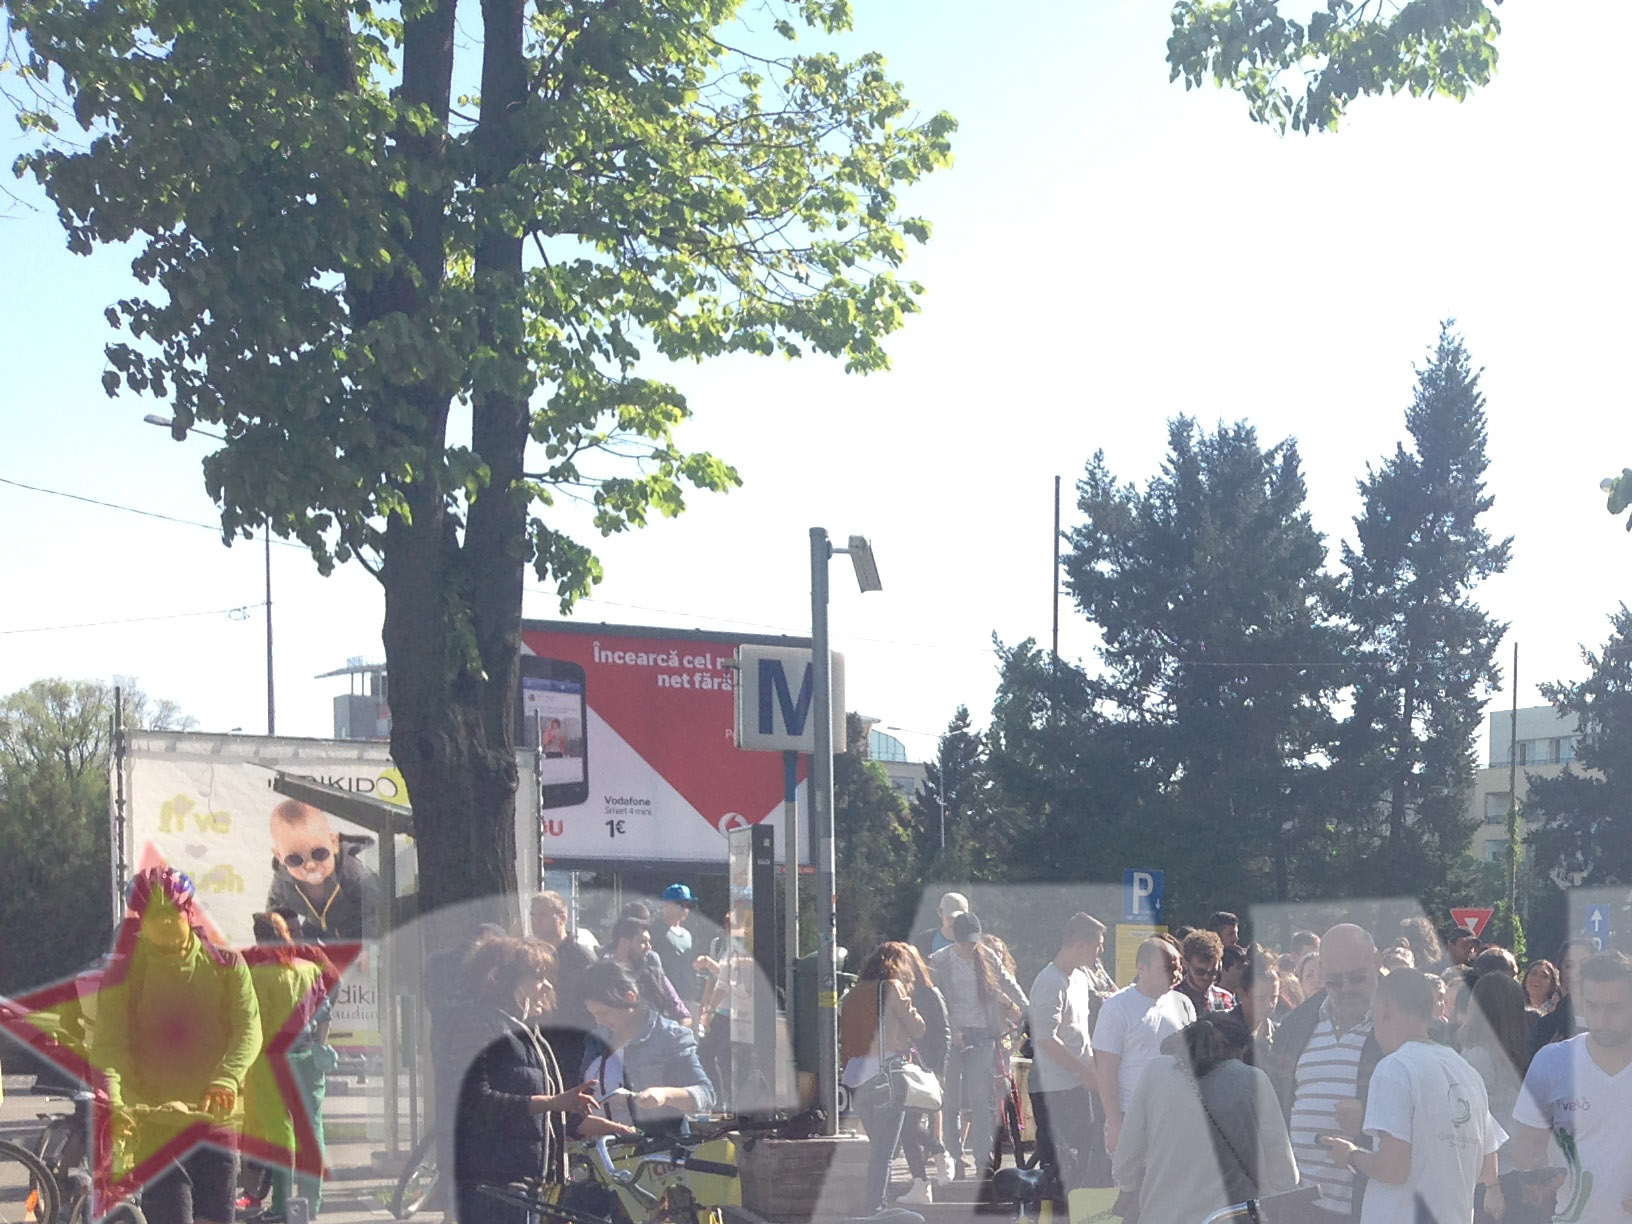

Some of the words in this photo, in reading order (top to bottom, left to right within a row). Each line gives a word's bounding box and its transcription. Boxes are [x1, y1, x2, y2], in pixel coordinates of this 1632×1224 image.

[593, 641, 680, 668] Încearcă
[683, 650, 713, 670] cel
[657, 674, 690, 689] net
[758, 658, 814, 736] M
[604, 796, 651, 806] Vodafone
[605, 819, 626, 837] 1€
[1132, 871, 1154, 915] P
